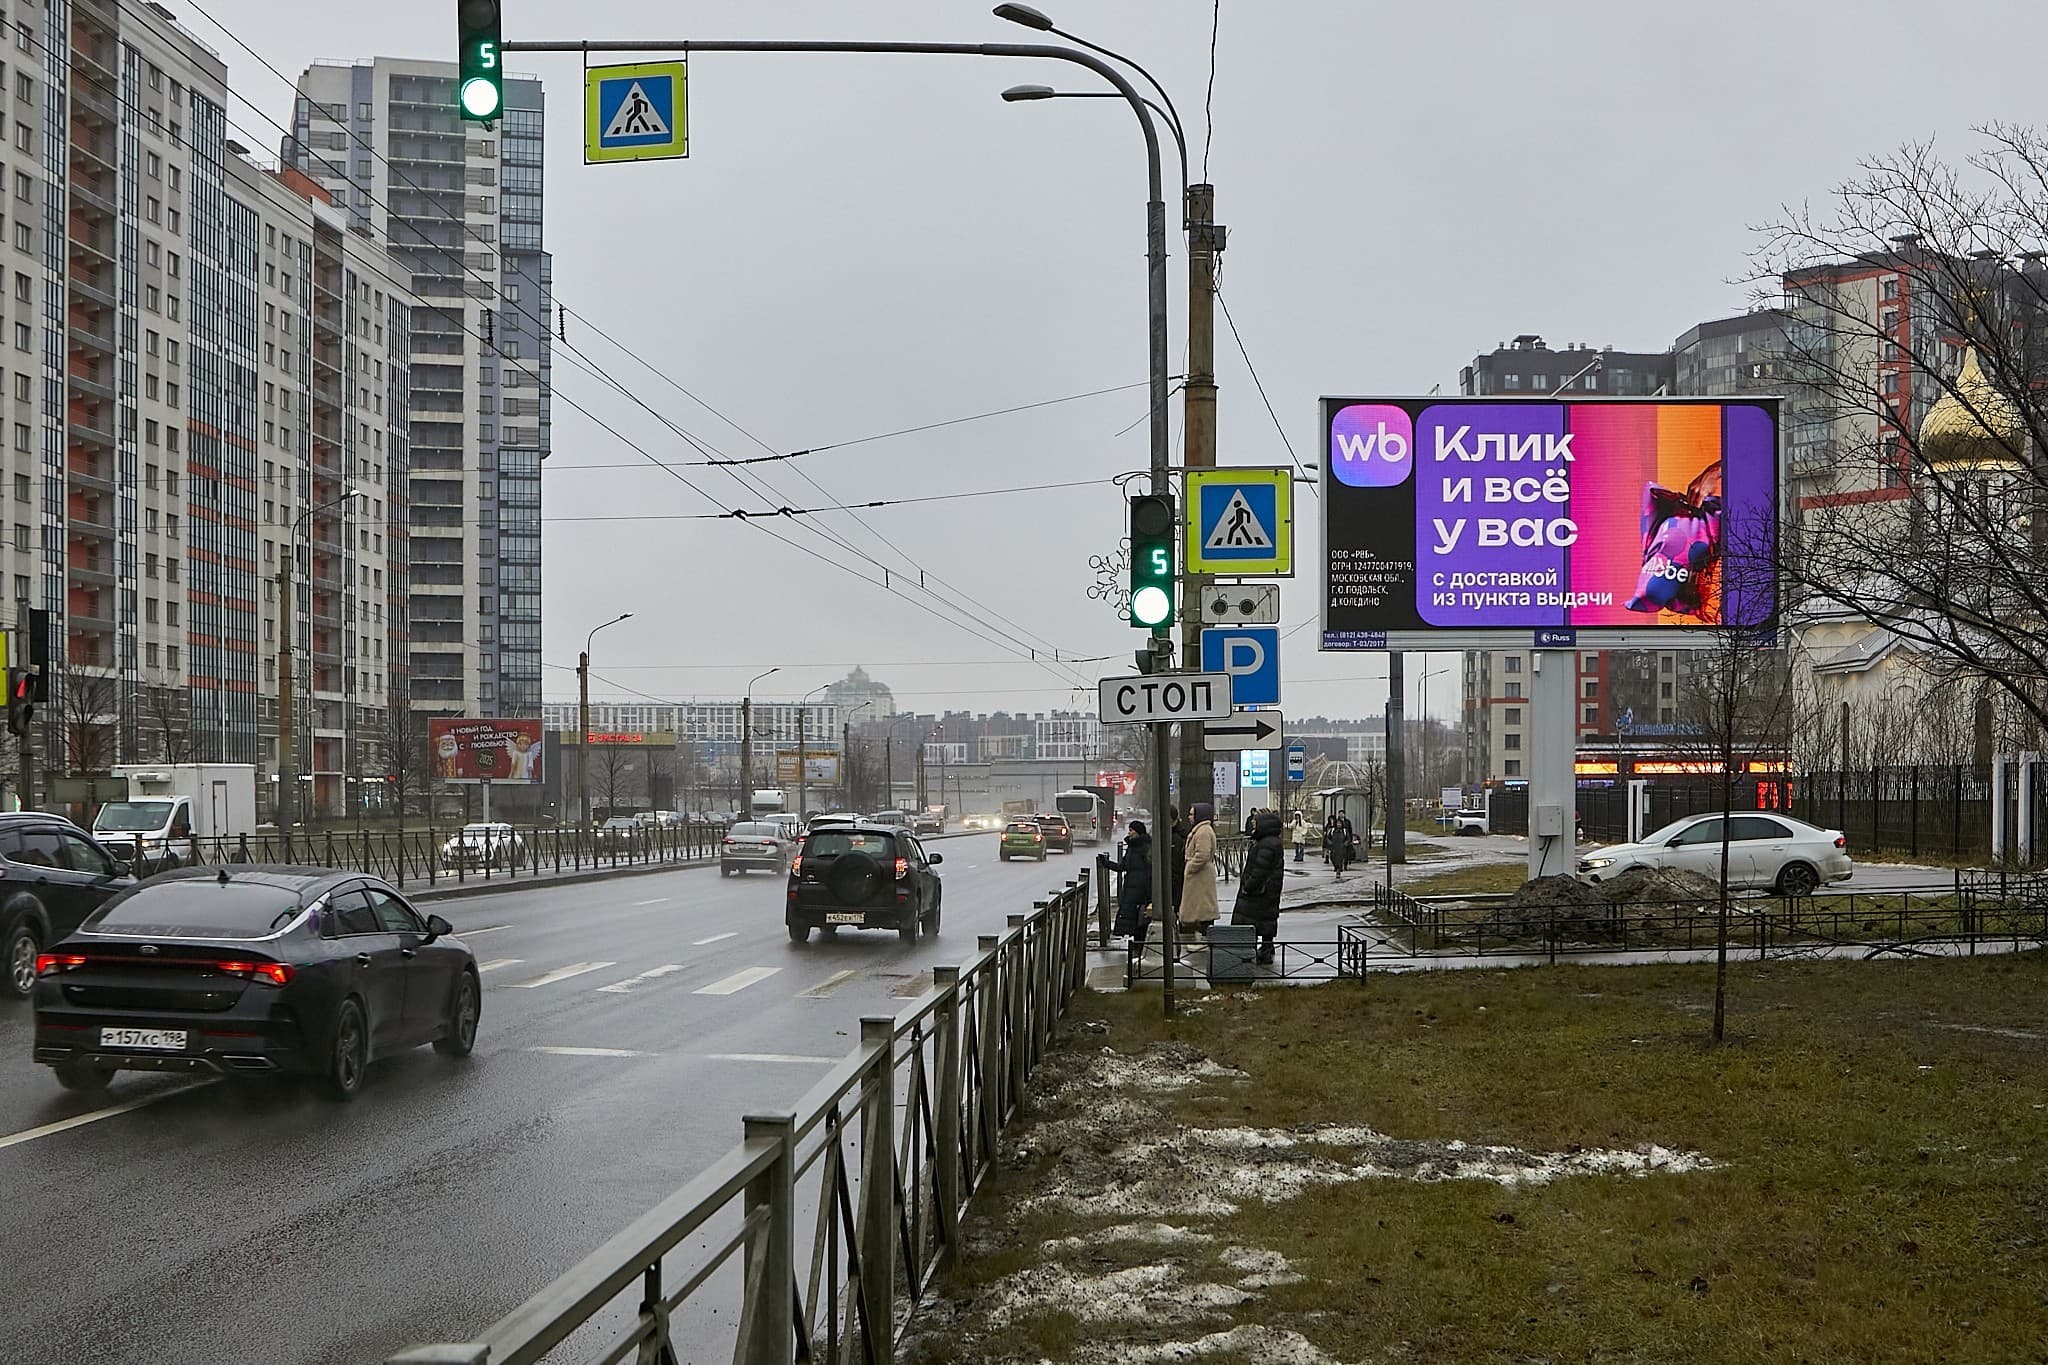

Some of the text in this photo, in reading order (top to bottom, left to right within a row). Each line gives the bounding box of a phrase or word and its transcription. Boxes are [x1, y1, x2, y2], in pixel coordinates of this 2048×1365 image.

[480, 43, 495, 68] 5
[1336, 422, 1408, 463] wb
[1434, 425, 1576, 462] Клик
[1442, 468, 1570, 503] и всё
[1433, 517, 1578, 555] у вас
[1152, 549, 1168, 575] 5
[1331, 561, 1351, 571] ОГРН
[1331, 573, 1383, 583] МОСКОВСКАЯ
[1432, 568, 1557, 589] с доставкой
[1433, 592, 1613, 610] из пункта выдачи
[1116, 681, 1213, 715] СТОП
[480, 725, 494, 733] ГОД
[480, 731, 518, 741] РОЖДЕСТВО
